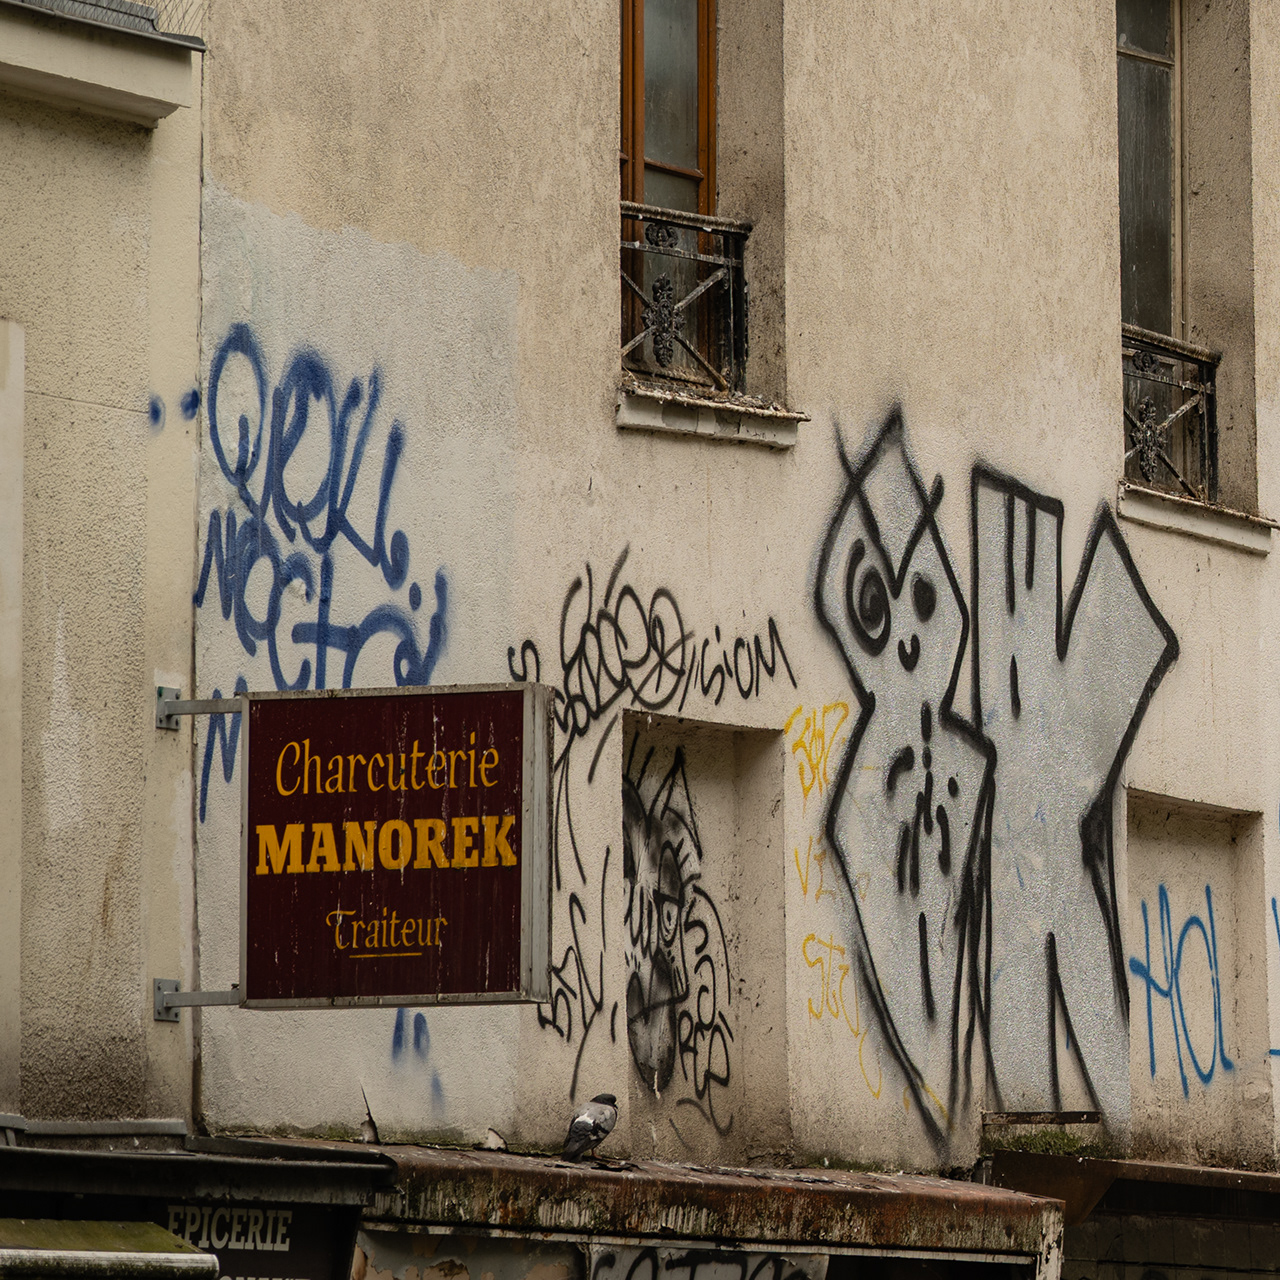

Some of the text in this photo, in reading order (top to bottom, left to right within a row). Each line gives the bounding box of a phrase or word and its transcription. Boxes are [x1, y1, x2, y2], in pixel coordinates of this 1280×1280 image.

[276, 731, 501, 797] Charcuterie
[255, 815, 519, 876] MANOREK
[326, 908, 449, 951] Traiteur
[167, 1205, 293, 1252] EPICERIE
